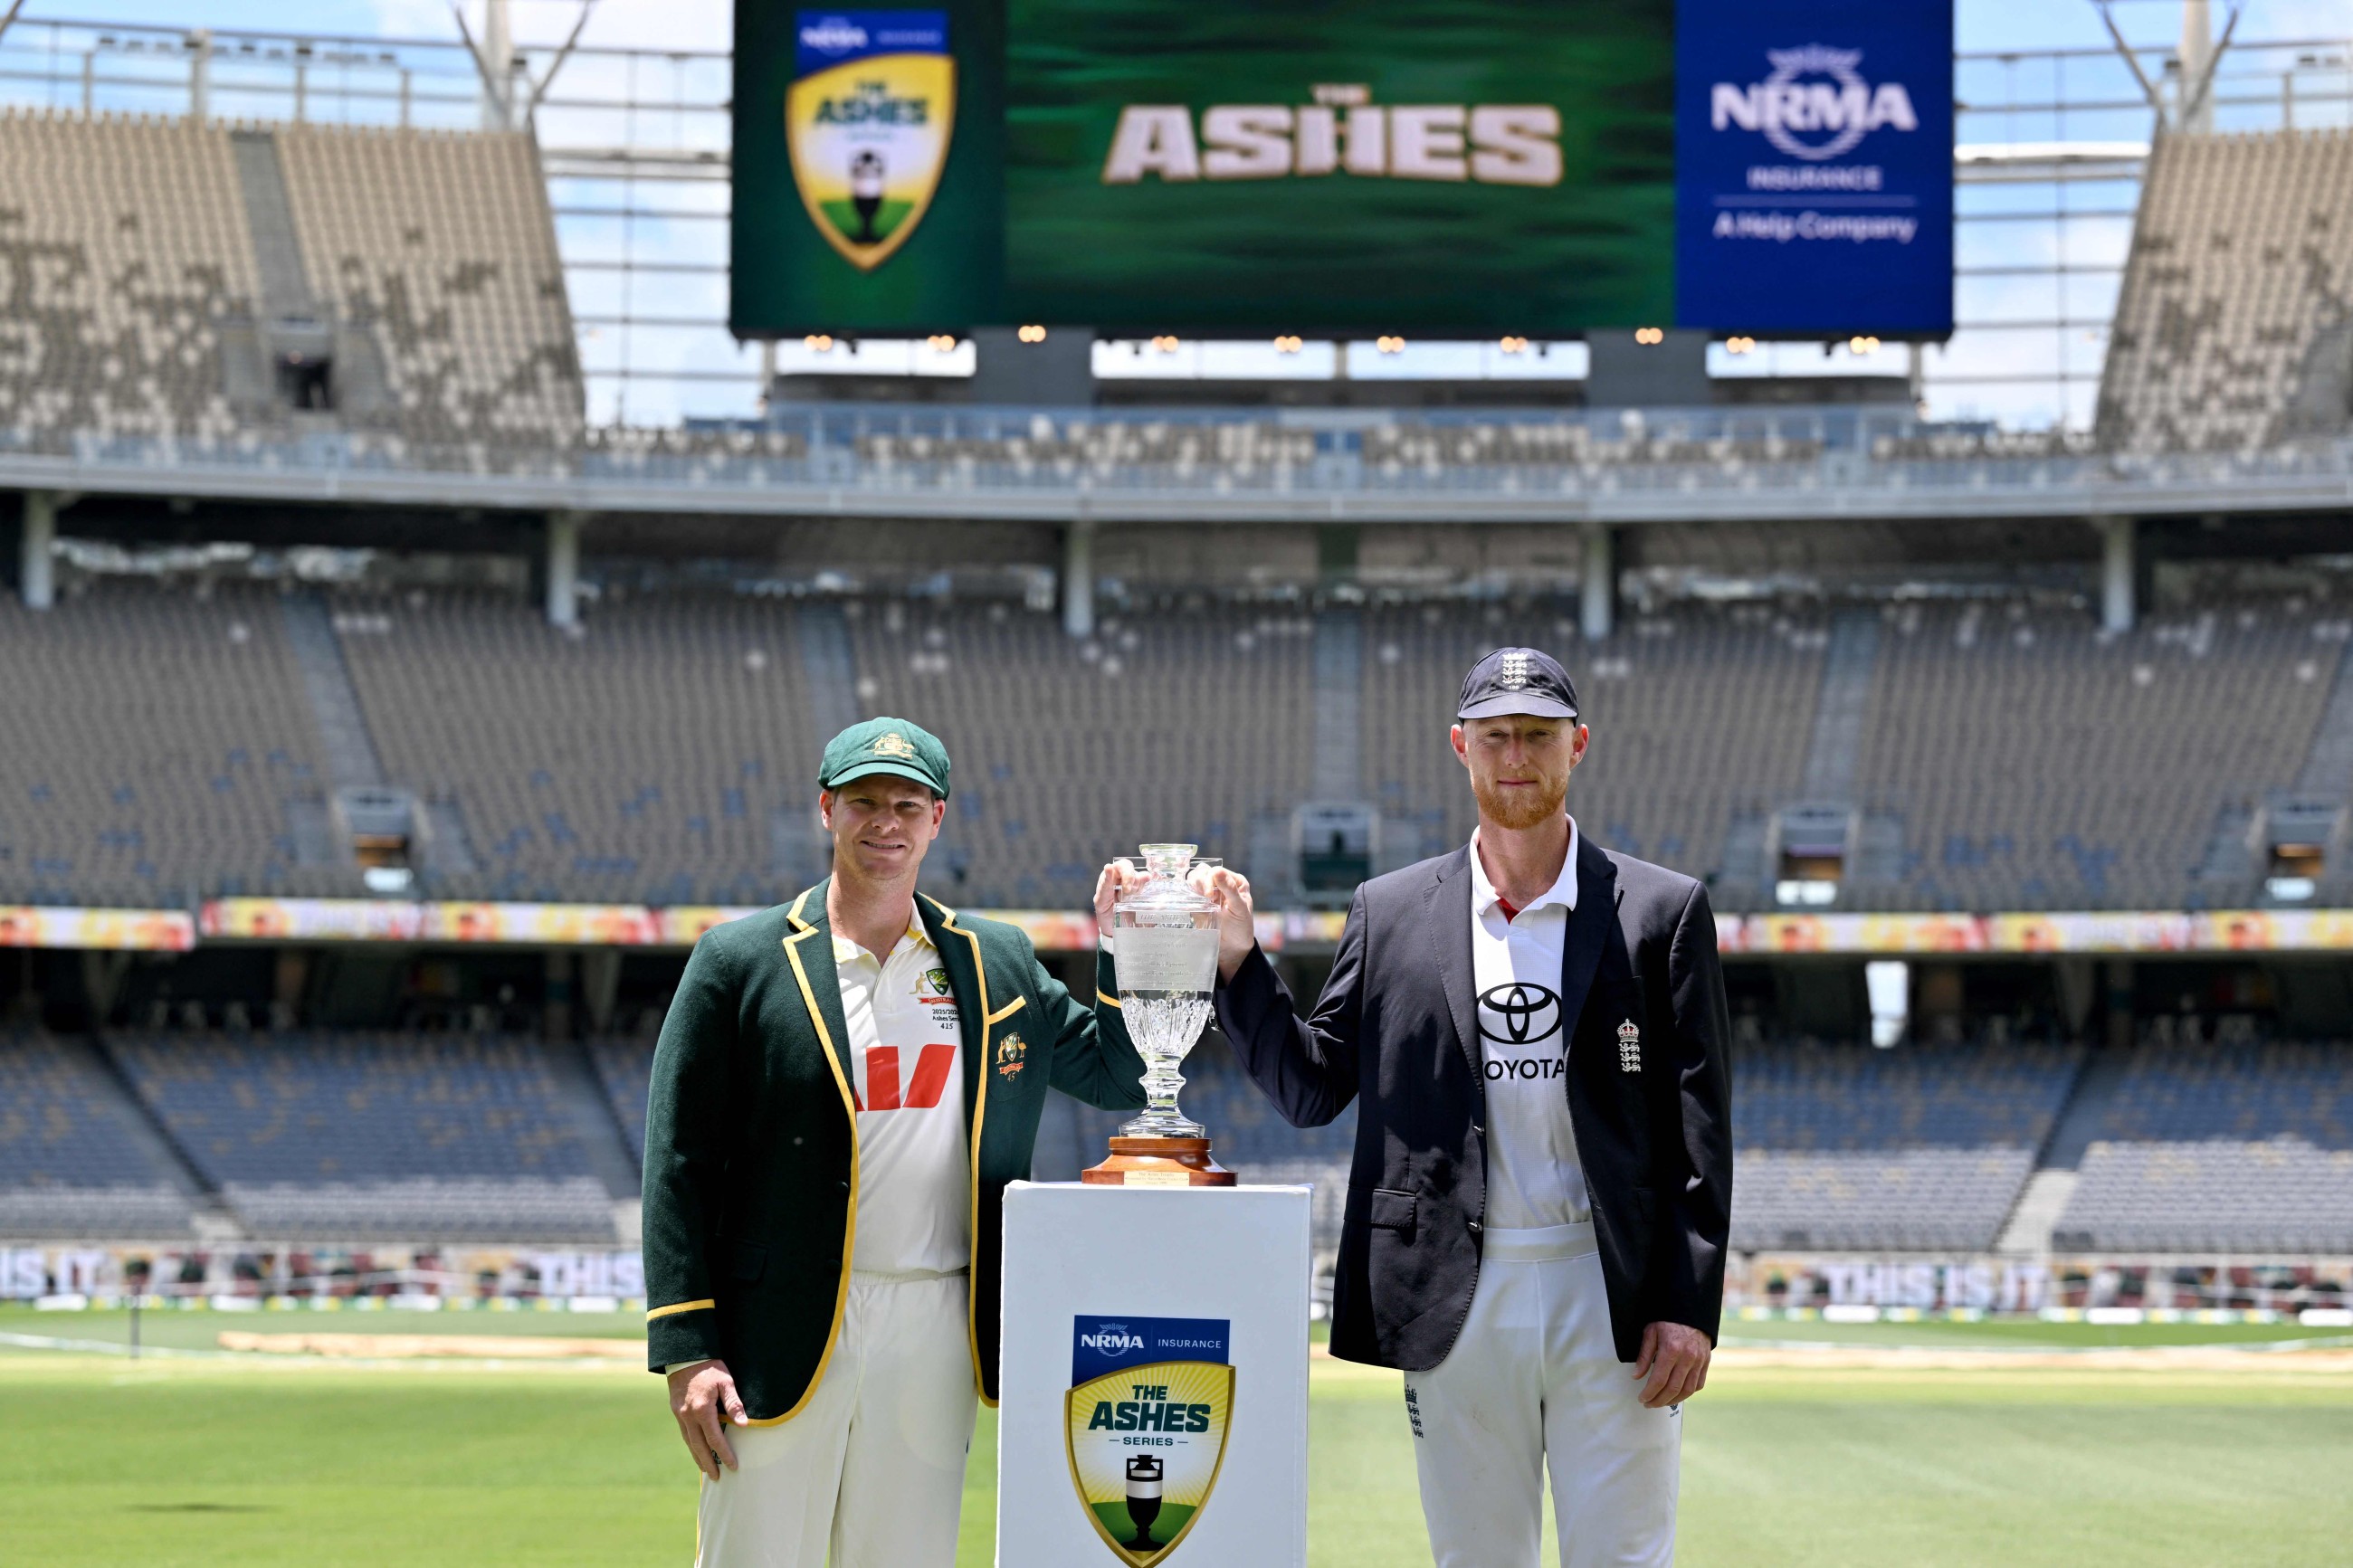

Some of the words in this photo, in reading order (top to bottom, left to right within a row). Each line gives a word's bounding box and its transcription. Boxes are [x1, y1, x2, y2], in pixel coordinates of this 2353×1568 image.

[814, 99, 928, 125] ASHES
[1710, 82, 1919, 131] NRMA
[1102, 104, 1563, 185] ASHES
[1747, 166, 1883, 191] INSURANCE
[1712, 211, 1736, 239] A
[1737, 211, 1796, 243] Help
[1797, 211, 1918, 244] Company
[1481, 1059, 1565, 1080] OYOTA
[536, 1253, 644, 1296] THIS
[1824, 1264, 1936, 1307] THIS
[1947, 1264, 1993, 1307] IS
[1081, 1334, 1145, 1349] NRMA
[1157, 1338, 1222, 1349] INSURANCE
[1132, 1384, 1168, 1401] THE
[1088, 1401, 1211, 1432] ASHES
[1122, 1436, 1174, 1446] SERIES
